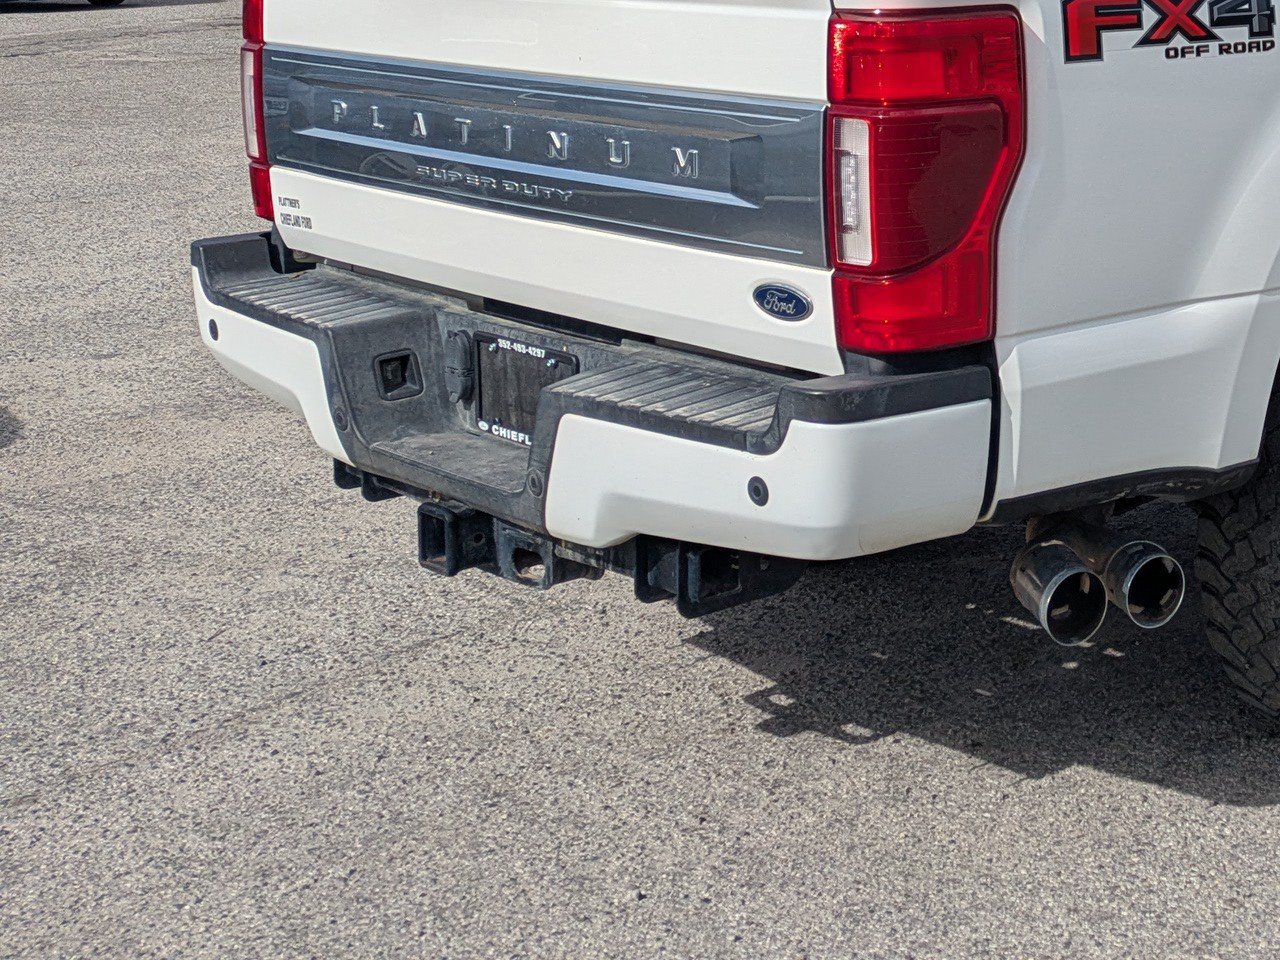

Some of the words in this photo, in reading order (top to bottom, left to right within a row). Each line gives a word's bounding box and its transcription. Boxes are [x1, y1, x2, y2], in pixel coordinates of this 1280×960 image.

[1164, 44, 1210, 60] OFF
[1218, 39, 1275, 56] ROAD
[331, 99, 699, 179] PLATINUM
[416, 165, 496, 189] SUPER
[501, 180, 573, 202] DUTY
[497, 338, 546, 359] 352-493-4297
[491, 424, 532, 446] CHIEFL
